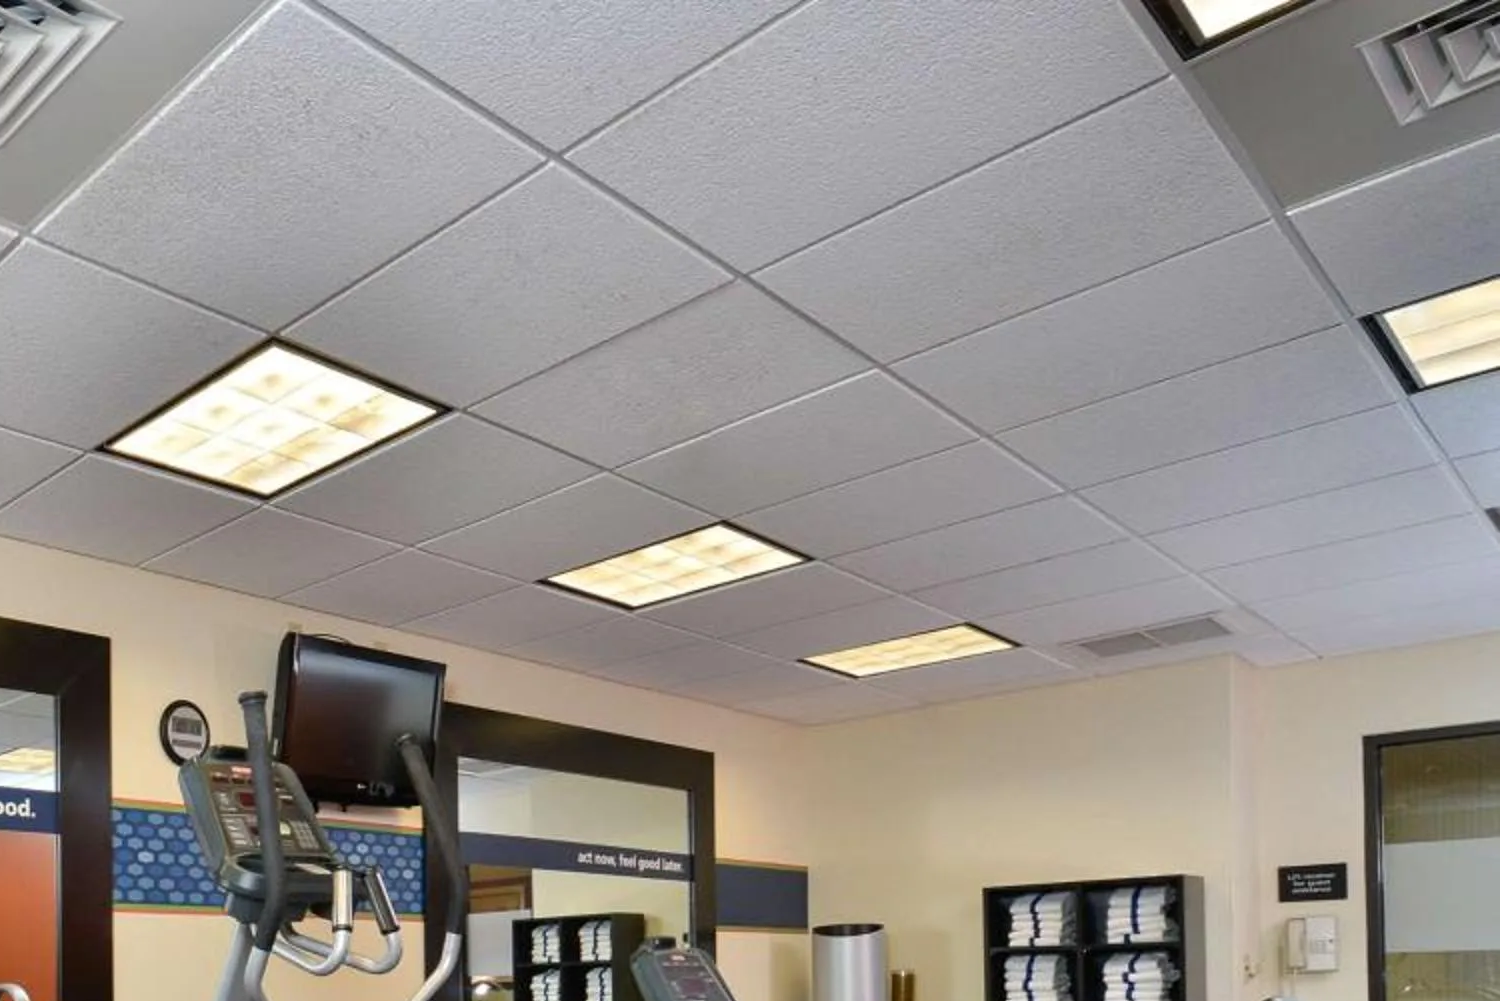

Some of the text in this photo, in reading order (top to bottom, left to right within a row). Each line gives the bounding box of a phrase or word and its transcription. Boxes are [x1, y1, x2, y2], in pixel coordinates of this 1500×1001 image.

[577, 851, 593, 864] act
[619, 853, 637, 869] feel
[638, 856, 661, 872] good
